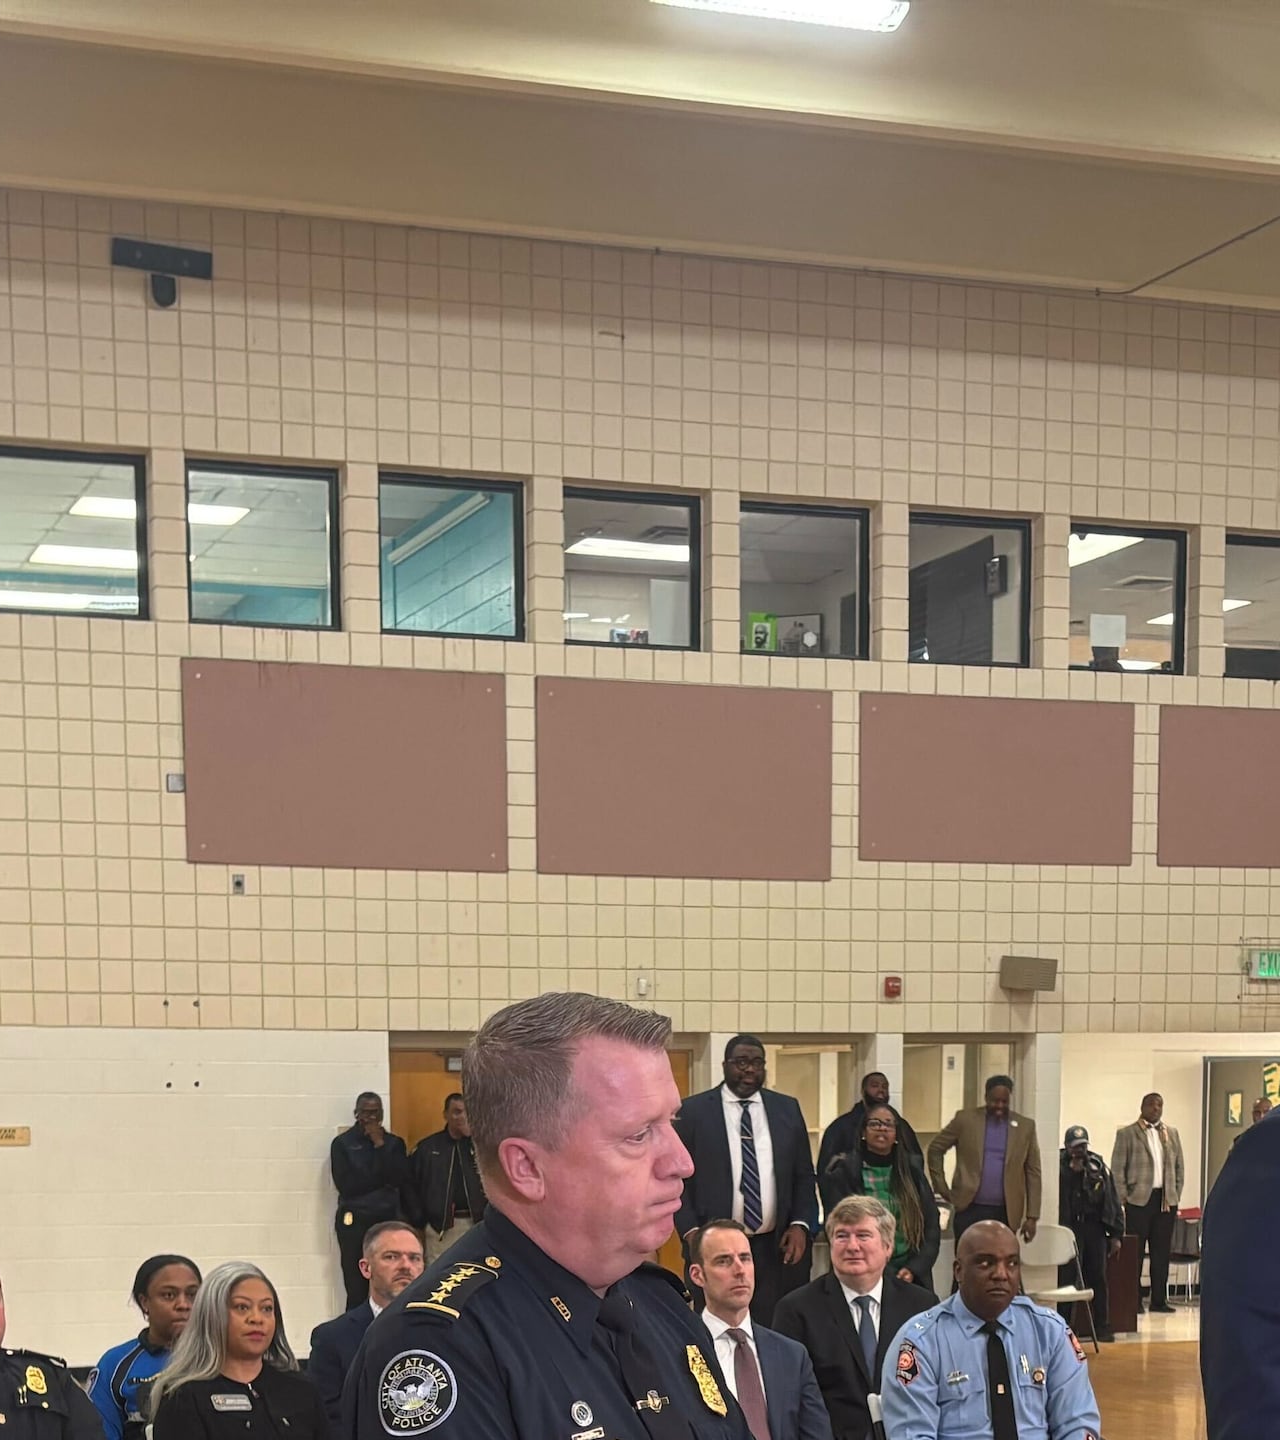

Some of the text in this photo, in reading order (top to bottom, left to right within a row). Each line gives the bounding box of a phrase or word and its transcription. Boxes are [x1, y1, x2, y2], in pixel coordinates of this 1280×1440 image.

[382, 1382, 391, 1409] CITY
[388, 1363, 402, 1380] OF
[405, 1358, 448, 1390] ATLANTA
[392, 1404, 442, 1428] POLICE
